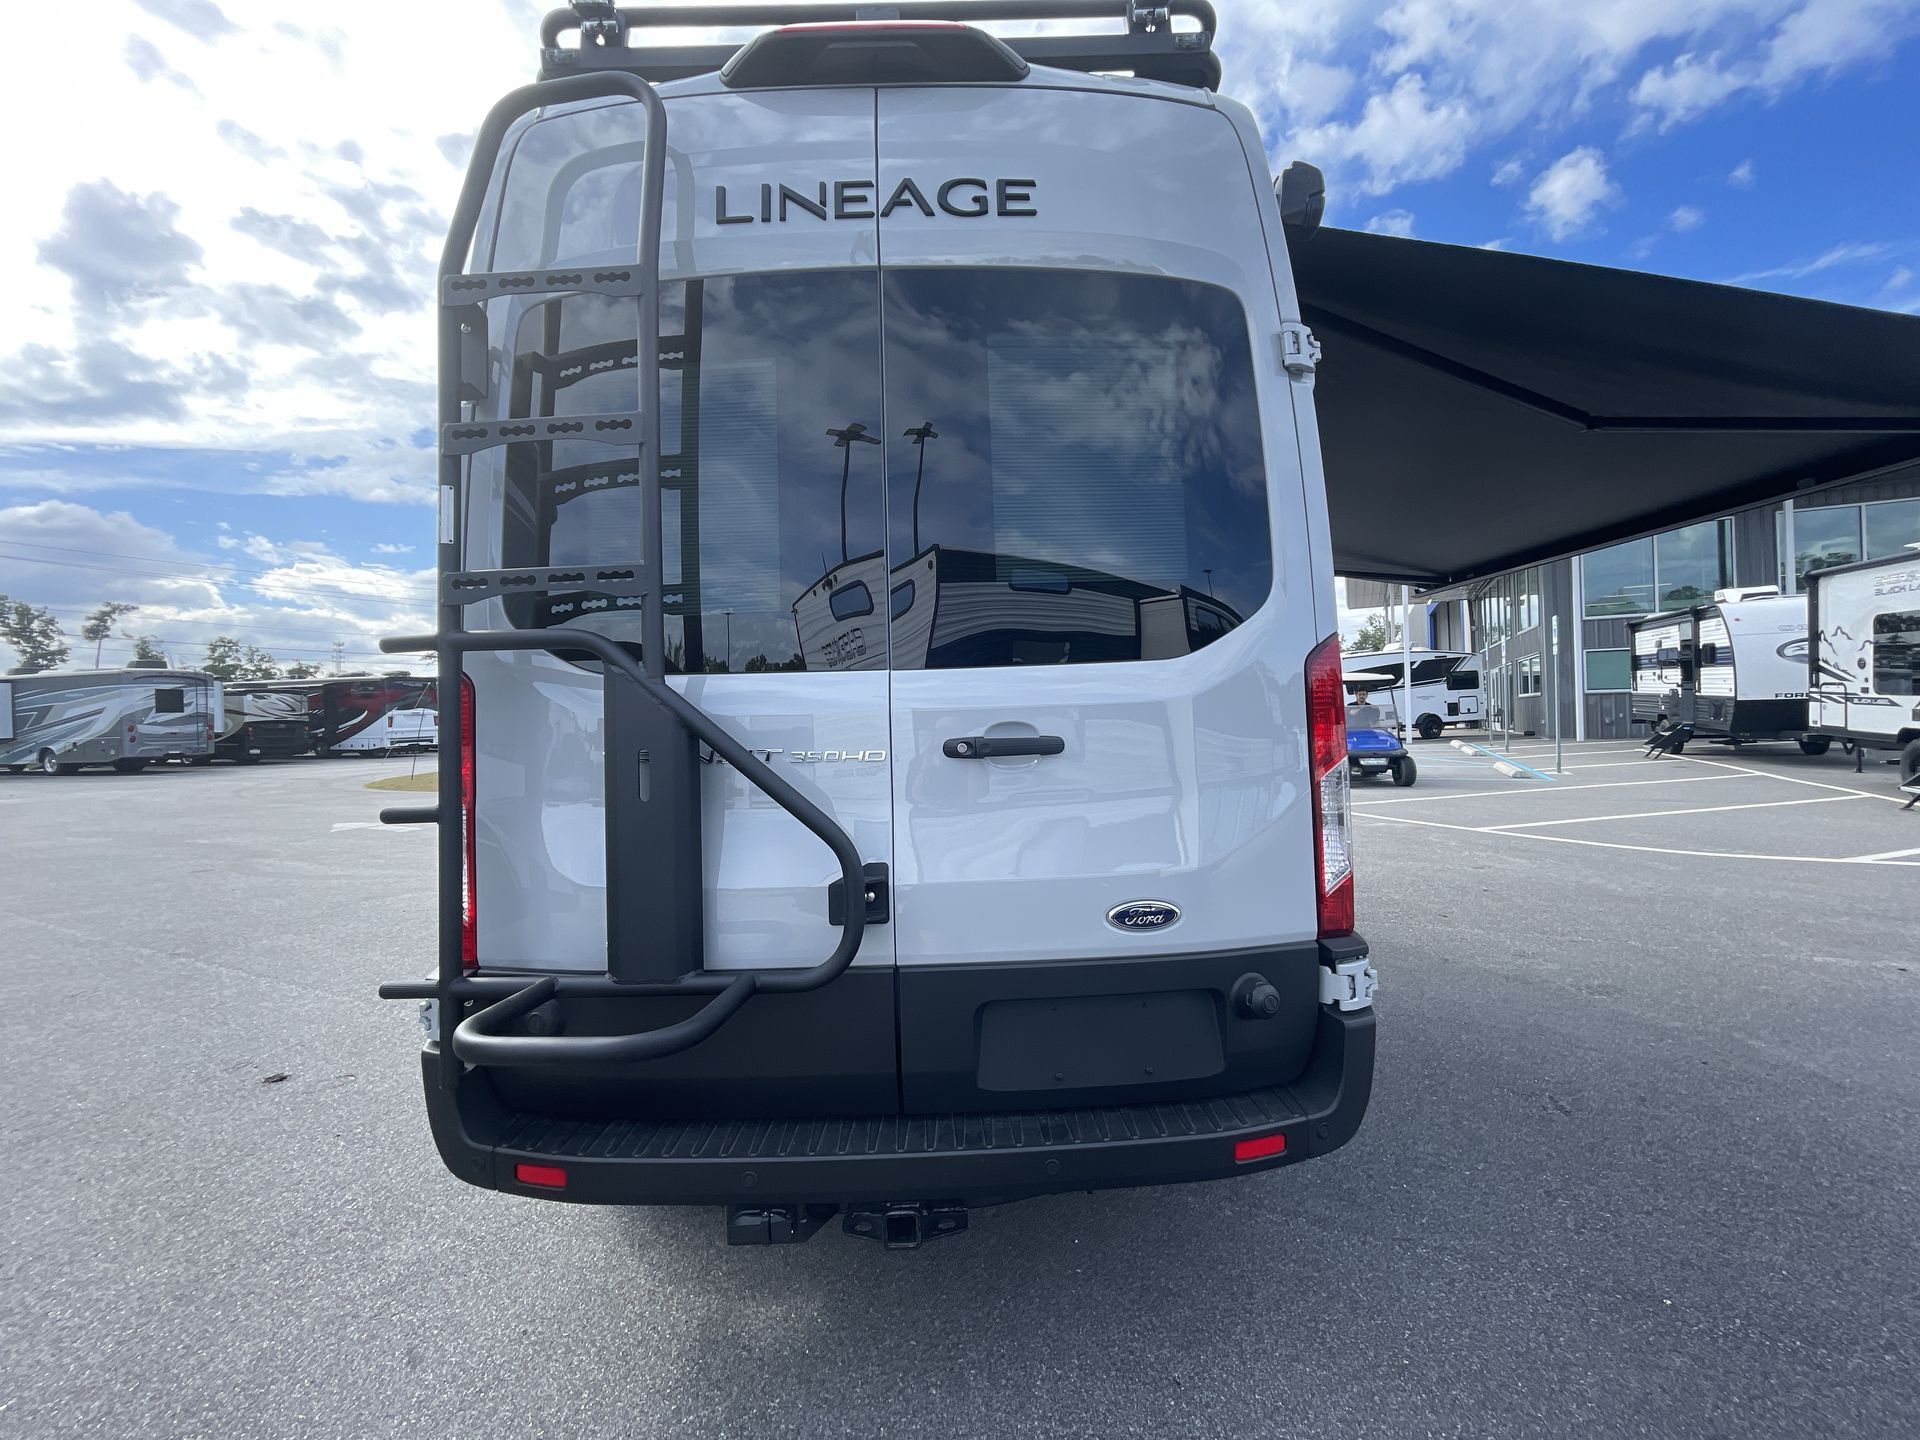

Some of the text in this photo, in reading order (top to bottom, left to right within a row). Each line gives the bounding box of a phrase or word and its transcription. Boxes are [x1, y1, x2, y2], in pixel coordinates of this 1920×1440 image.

[715, 177, 1038, 225] LINEAGE
[1875, 584, 1906, 597] BLACK
[789, 749, 888, 764] 350HD
[1124, 907, 1166, 926] Ford
